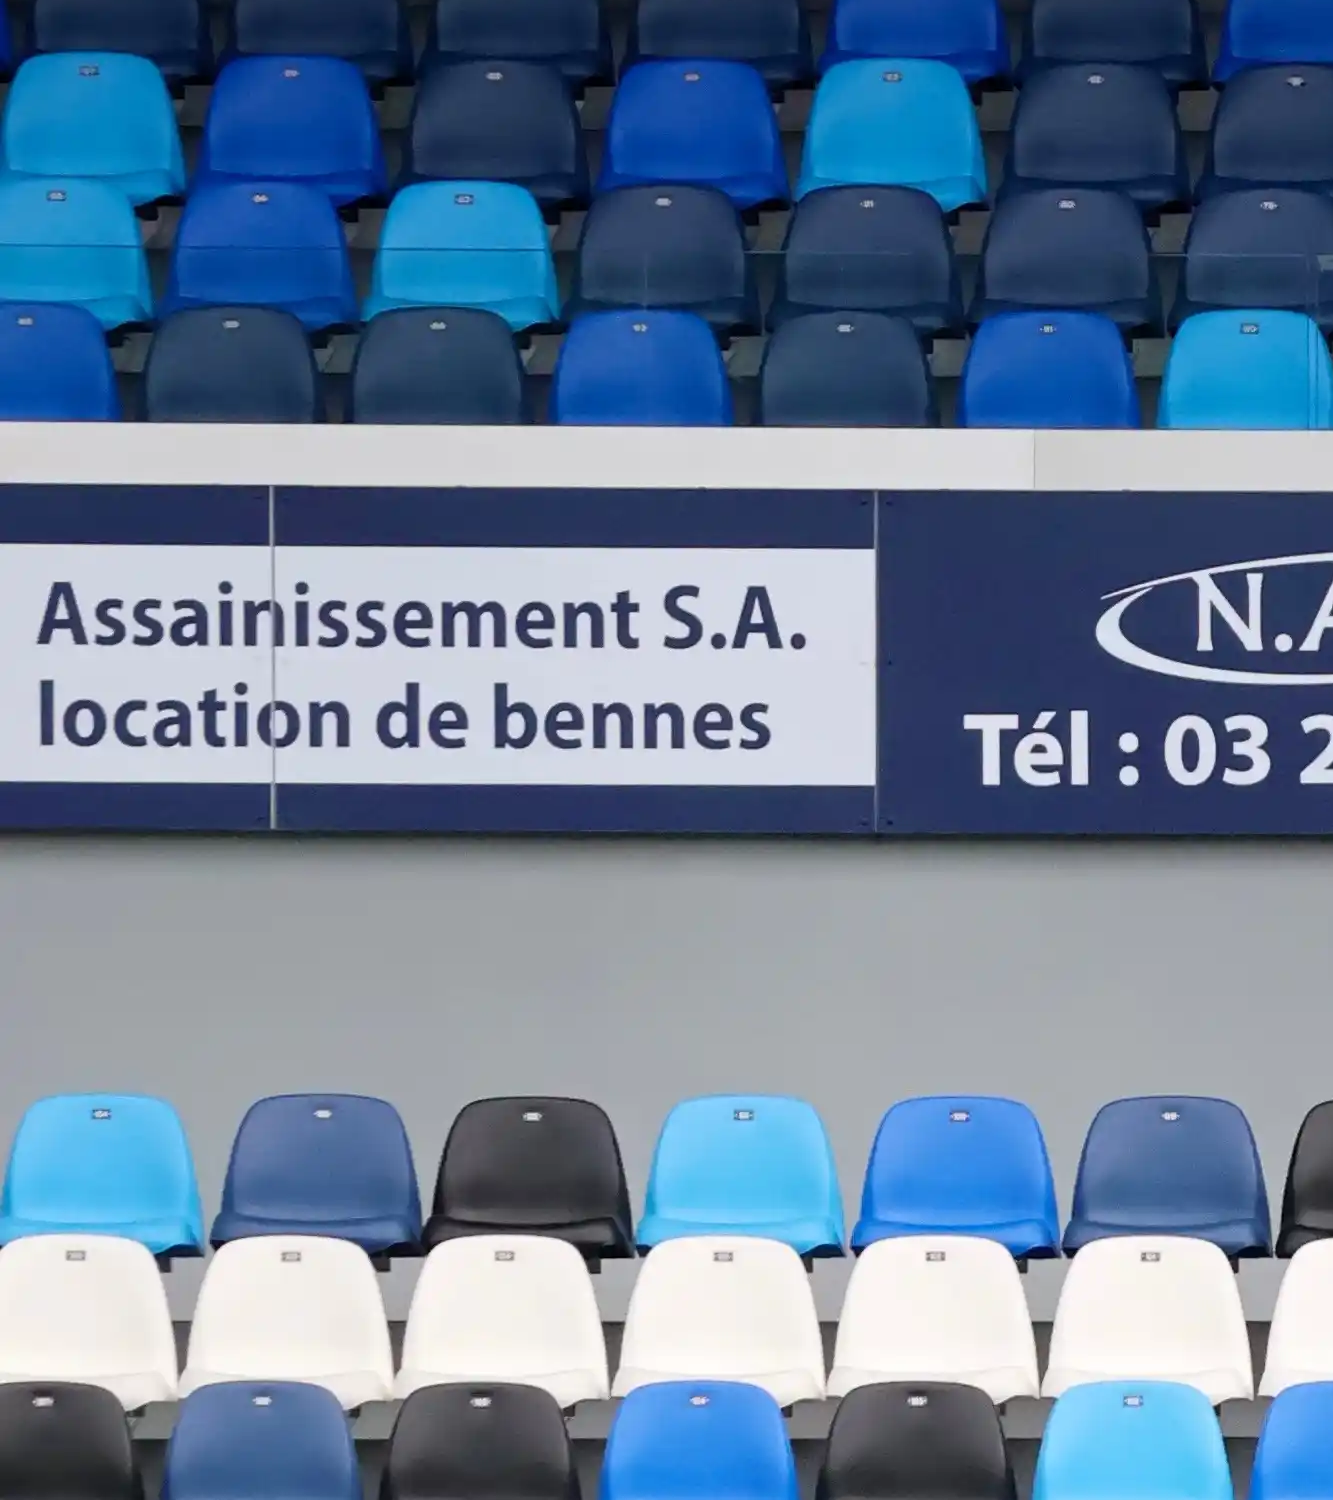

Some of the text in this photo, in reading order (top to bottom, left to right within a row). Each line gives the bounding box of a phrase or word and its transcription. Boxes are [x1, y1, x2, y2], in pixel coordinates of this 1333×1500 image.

[37, 581, 807, 651] Assainissement S.A.
[39, 679, 773, 751] location de bennes
[1164, 712, 1271, 786] 03
